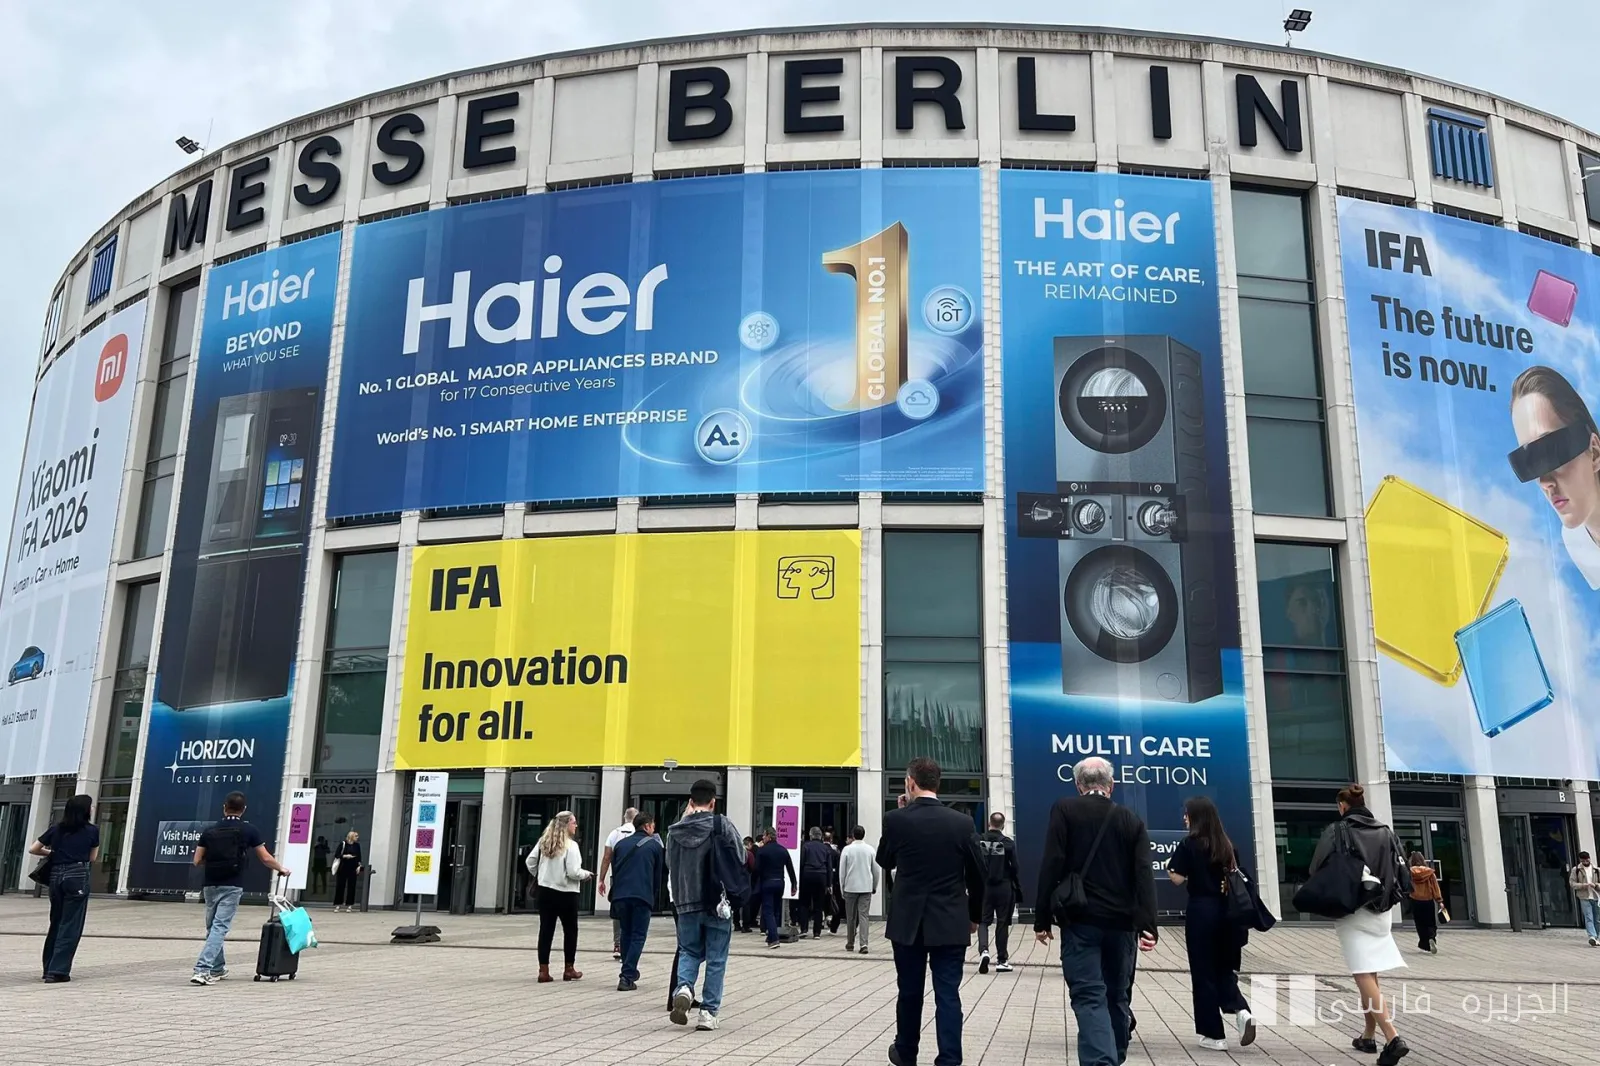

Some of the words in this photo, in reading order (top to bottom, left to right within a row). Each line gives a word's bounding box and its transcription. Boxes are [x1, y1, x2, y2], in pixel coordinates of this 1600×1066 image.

[164, 91, 520, 257] MESSE
[667, 55, 1303, 153] BERLIN
[1034, 197, 1180, 245] Haier
[1364, 228, 1432, 277] IFA
[867, 256, 886, 304] NO.1
[1014, 260, 1056, 276] THE
[1062, 261, 1104, 278] ART
[1110, 263, 1139, 279] OF
[1145, 265, 1205, 287] CARE,
[222, 268, 315, 320] Haier
[403, 254, 668, 355] Haier
[1045, 283, 1178, 304] REIMAGINED
[225, 321, 302, 355] BEYOND
[1371, 294, 1435, 336] The
[1441, 305, 1534, 354] future
[223, 355, 253, 373] WHAT
[255, 349, 276, 365] YOU
[279, 344, 300, 360] SEE
[359, 381, 382, 395] No.
[386, 378, 392, 391] 1
[396, 370, 459, 390] GLOBAL
[468, 362, 528, 382] MAJOR
[532, 353, 645, 375] APPLIANCES
[651, 350, 719, 367] BRAND
[867, 309, 886, 401] GLOBAL
[1381, 342, 1413, 380] is
[1418, 354, 1497, 393] now.
[440, 388, 459, 402] for
[463, 386, 477, 399] 17
[480, 378, 571, 398] Consecutive
[574, 376, 616, 390] Years
[377, 427, 429, 445] World's
[432, 425, 457, 439] No.
[460, 424, 466, 436] 1
[470, 418, 525, 435] SMART
[528, 415, 578, 430] HOME
[583, 409, 688, 427] ENTERPRISE
[25, 427, 100, 518] Xiaomi
[18, 517, 39, 564] IFA
[40, 490, 89, 550] 2026
[34, 566, 47, 584] Car
[54, 555, 80, 577] Home
[429, 564, 502, 612] IFA
[421, 646, 628, 690] Innovation
[418, 703, 471, 743] for
[477, 700, 534, 741] all.
[180, 738, 255, 761] HORIZON
[1051, 733, 1132, 756] MULTI
[1140, 735, 1212, 758] CARE
[177, 774, 252, 784] COLLECTION
[418, 775, 430, 783] IFA
[1057, 763, 1208, 786] CECTION
[777, 792, 789, 800] IFA
[1558, 791, 1566, 803] B
[161, 845, 177, 855] Hall
[178, 845, 189, 856] 3.1
[163, 829, 181, 841] Visit
[182, 830, 203, 841] Haie
[1150, 840, 1180, 854] Pavi
